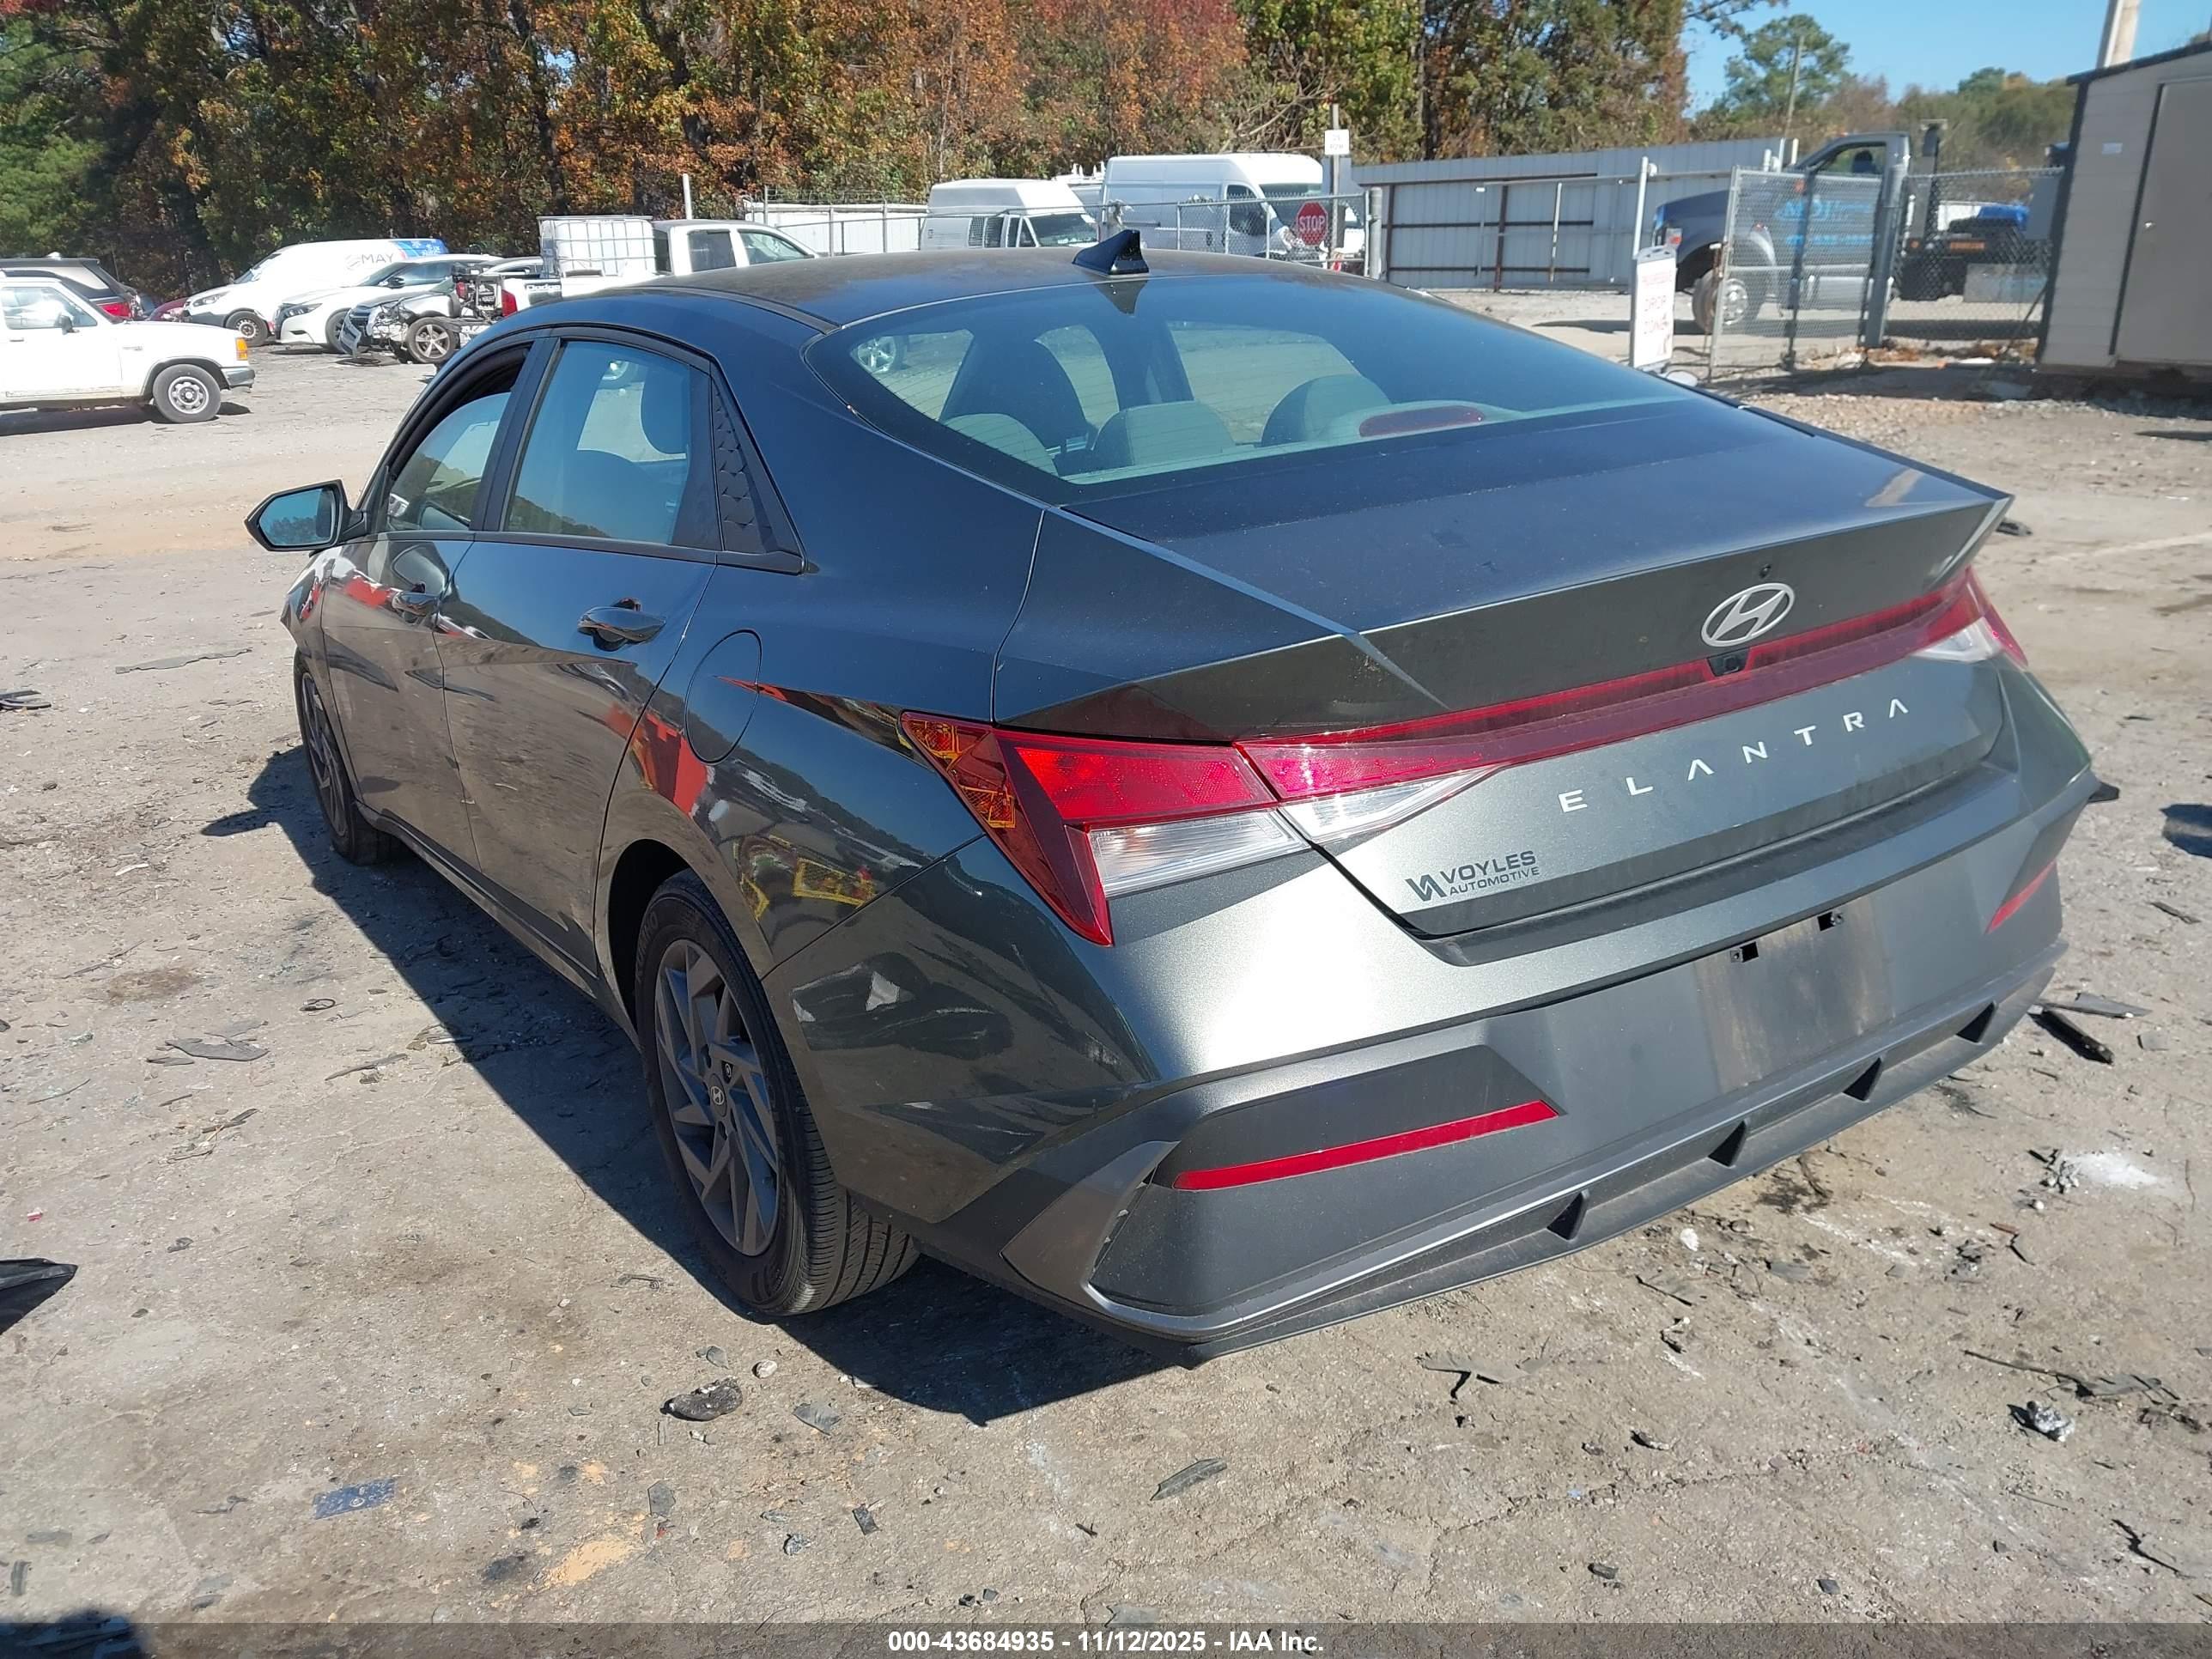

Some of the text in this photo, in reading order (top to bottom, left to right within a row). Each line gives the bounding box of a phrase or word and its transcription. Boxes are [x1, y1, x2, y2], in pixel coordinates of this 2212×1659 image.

[1298, 216, 1325, 232] STOP
[1558, 698, 1908, 812] ELANTRA
[1440, 850, 1536, 884] VOYLES
[1449, 866, 1540, 896] AUTOMOTIVE
